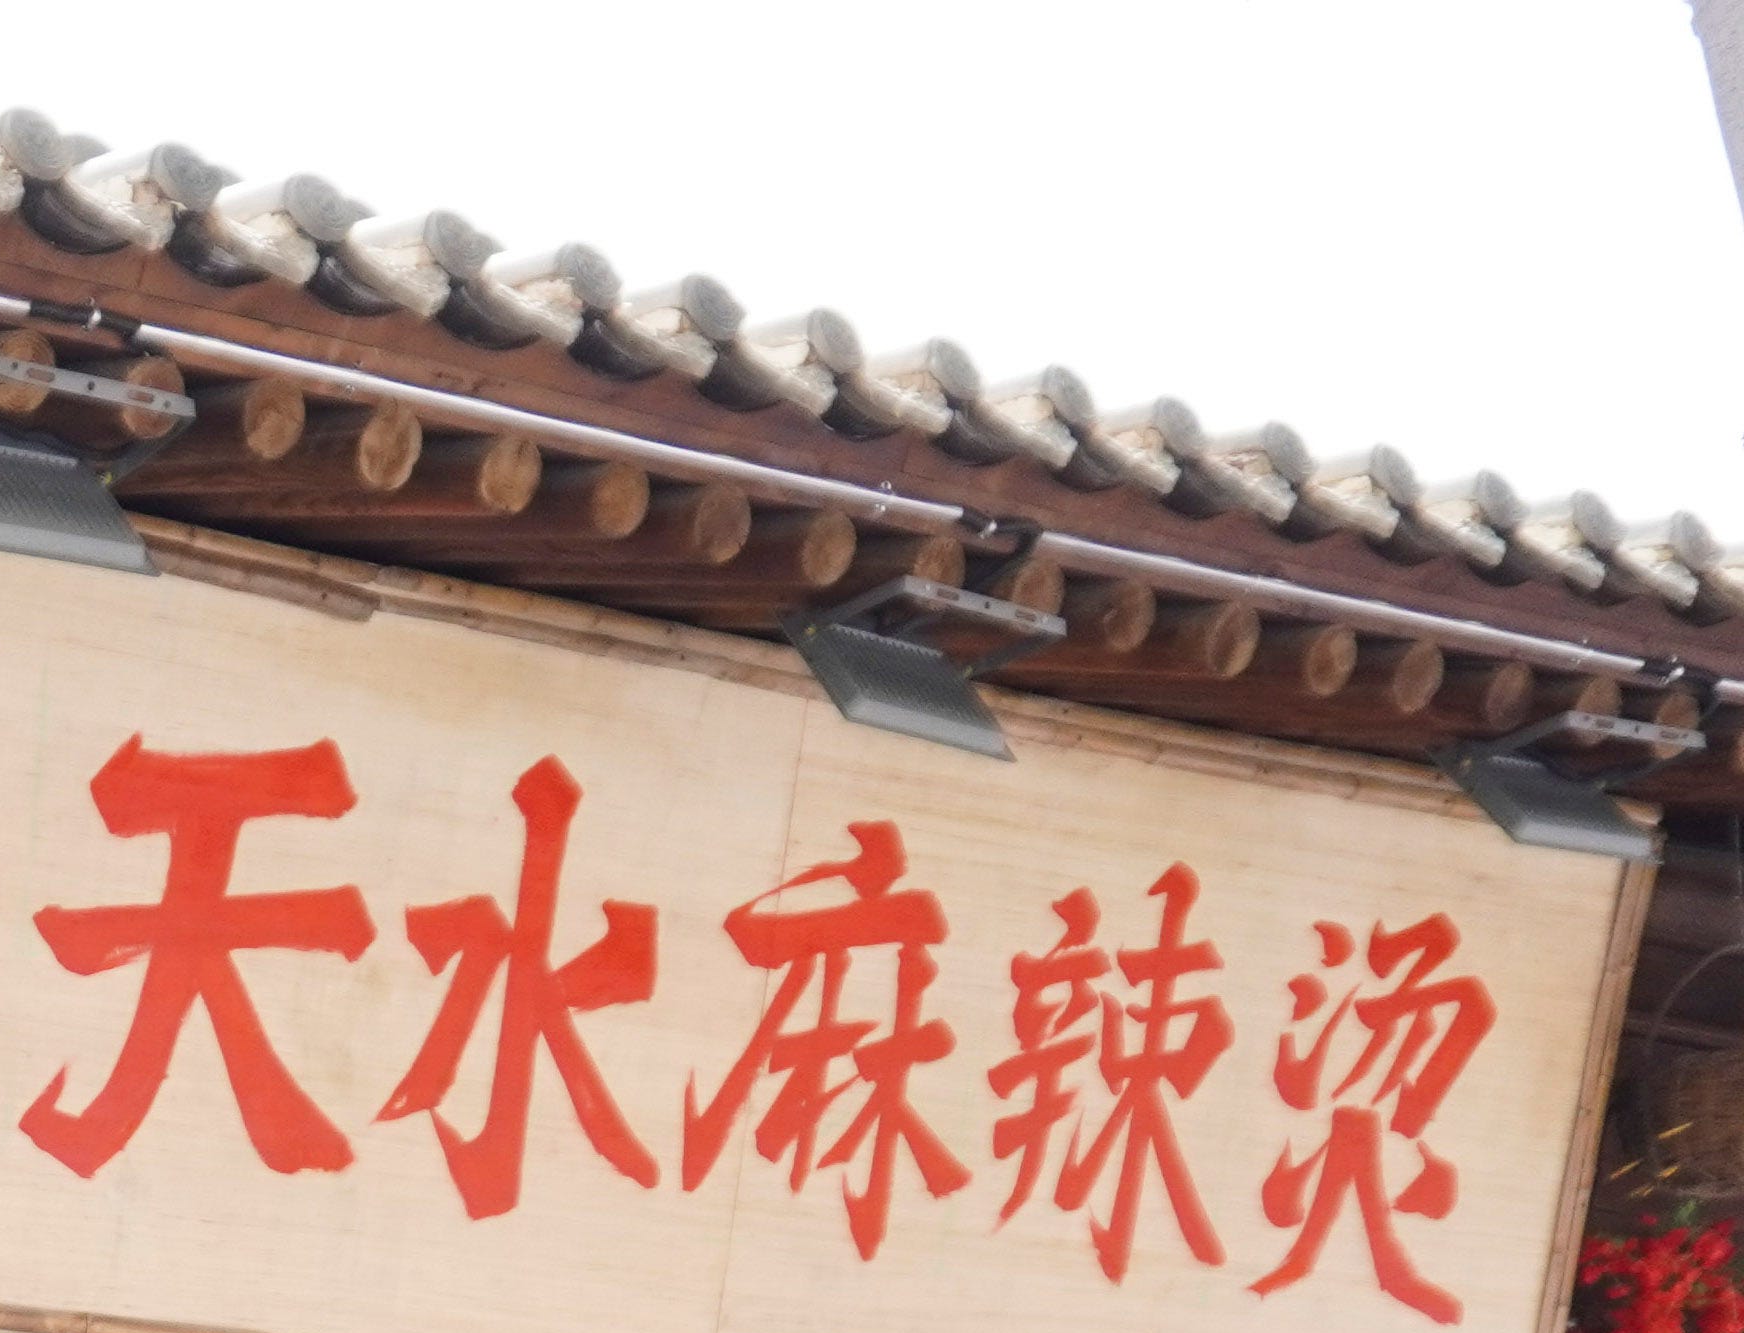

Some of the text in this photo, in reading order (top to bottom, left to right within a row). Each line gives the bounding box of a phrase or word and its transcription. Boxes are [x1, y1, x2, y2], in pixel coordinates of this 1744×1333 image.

[19, 734, 1495, 1324] 天水麻辣烫
